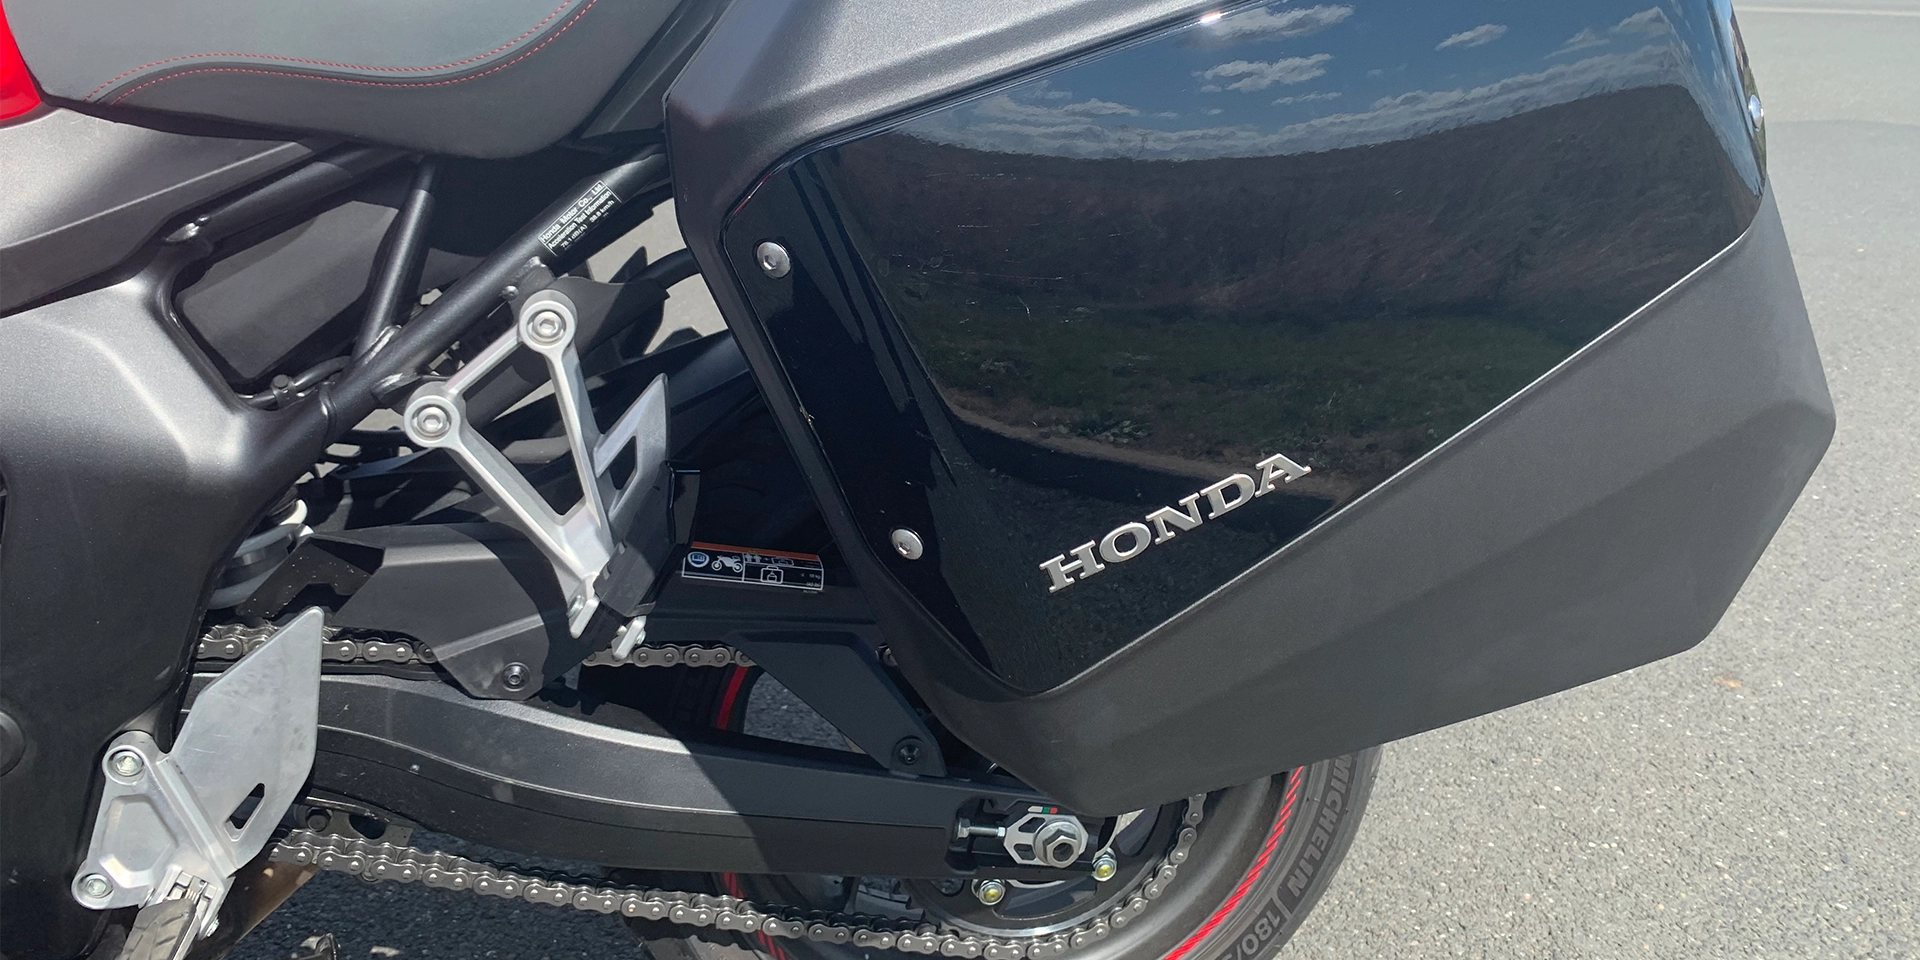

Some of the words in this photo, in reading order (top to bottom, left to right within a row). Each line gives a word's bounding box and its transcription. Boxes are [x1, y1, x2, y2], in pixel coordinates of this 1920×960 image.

[540, 224, 561, 242] Honda
[560, 207, 578, 224] Motor
[578, 196, 593, 207] Co.,
[548, 222, 578, 249] Acceleration
[574, 213, 588, 224] Test
[584, 191, 612, 215] Information
[600, 200, 615, 213] km/h
[1039, 453, 1312, 593] HONDA
[1287, 754, 1352, 898] MICHELIN
[1222, 910, 1280, 960] 180/
